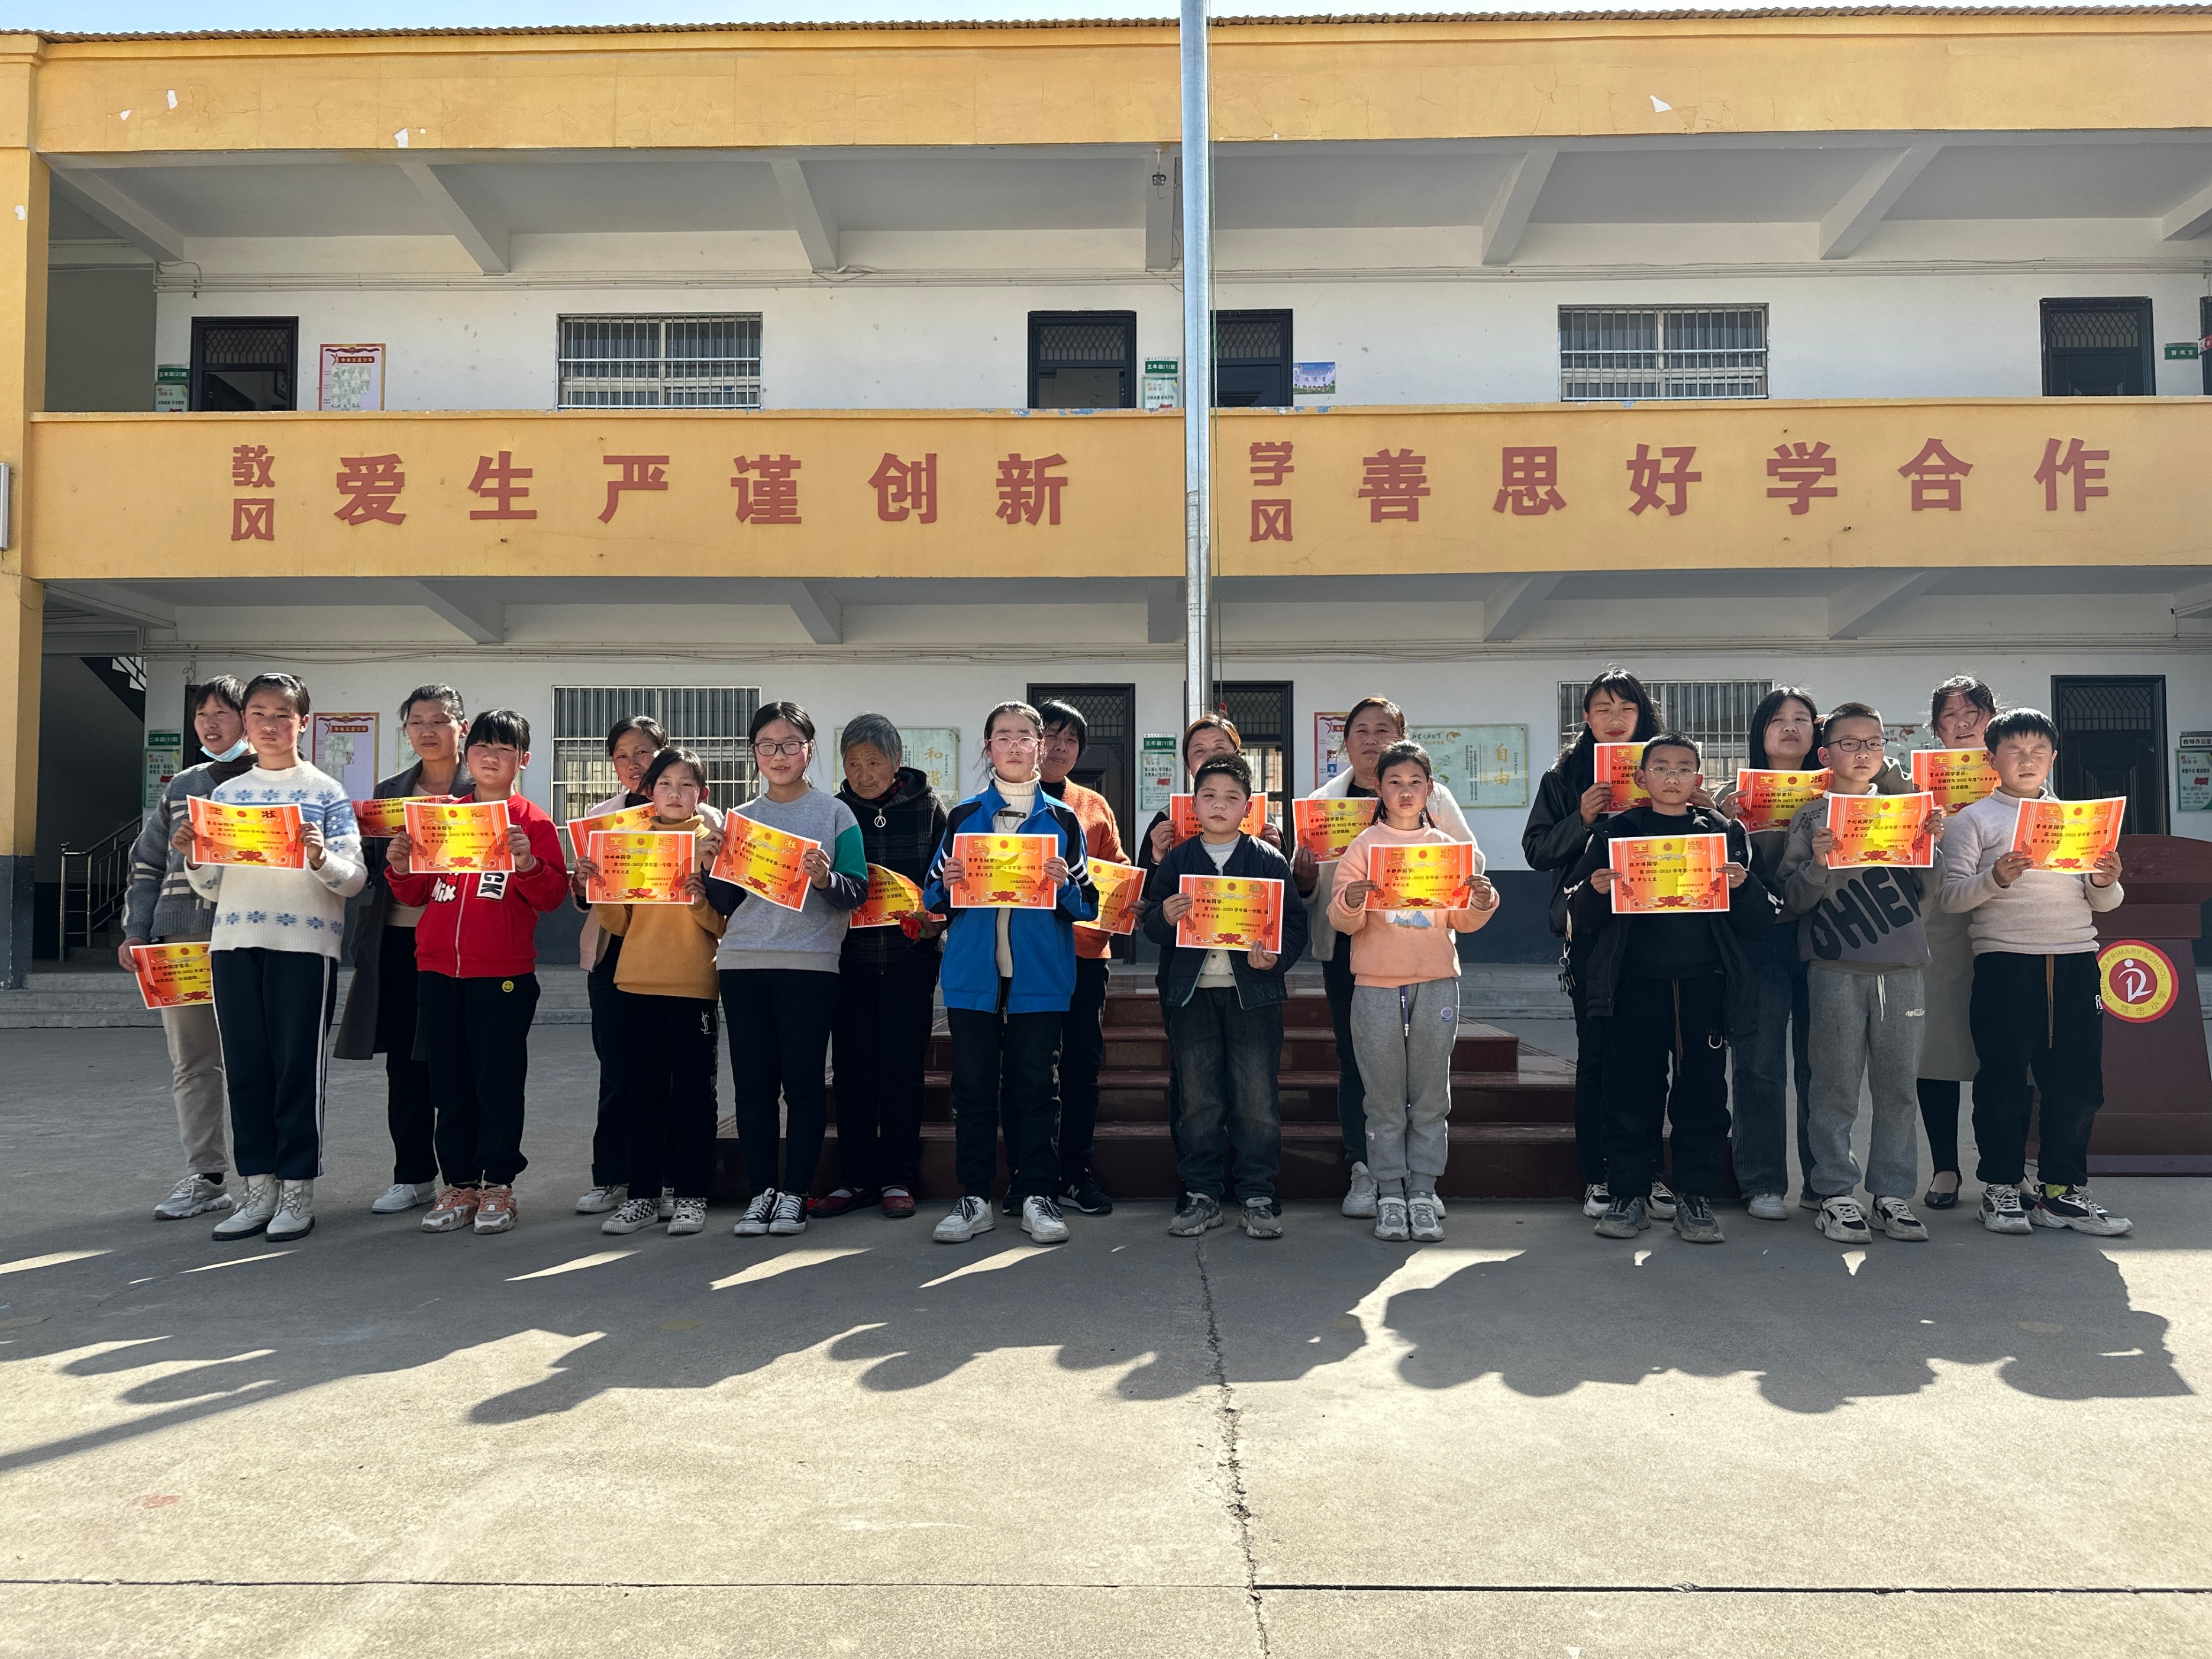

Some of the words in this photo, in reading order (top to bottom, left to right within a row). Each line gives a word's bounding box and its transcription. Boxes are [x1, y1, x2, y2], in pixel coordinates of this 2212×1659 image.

[334, 451, 1068, 525] 爱生严谨创新
[1358, 438, 2110, 523] 善思好学合作
[1494, 743, 1510, 786] 自由
[480, 872, 505, 896] CK
[2106, 948, 2142, 963] PRIMARY
[2143, 952, 2167, 980] SCHOOL
